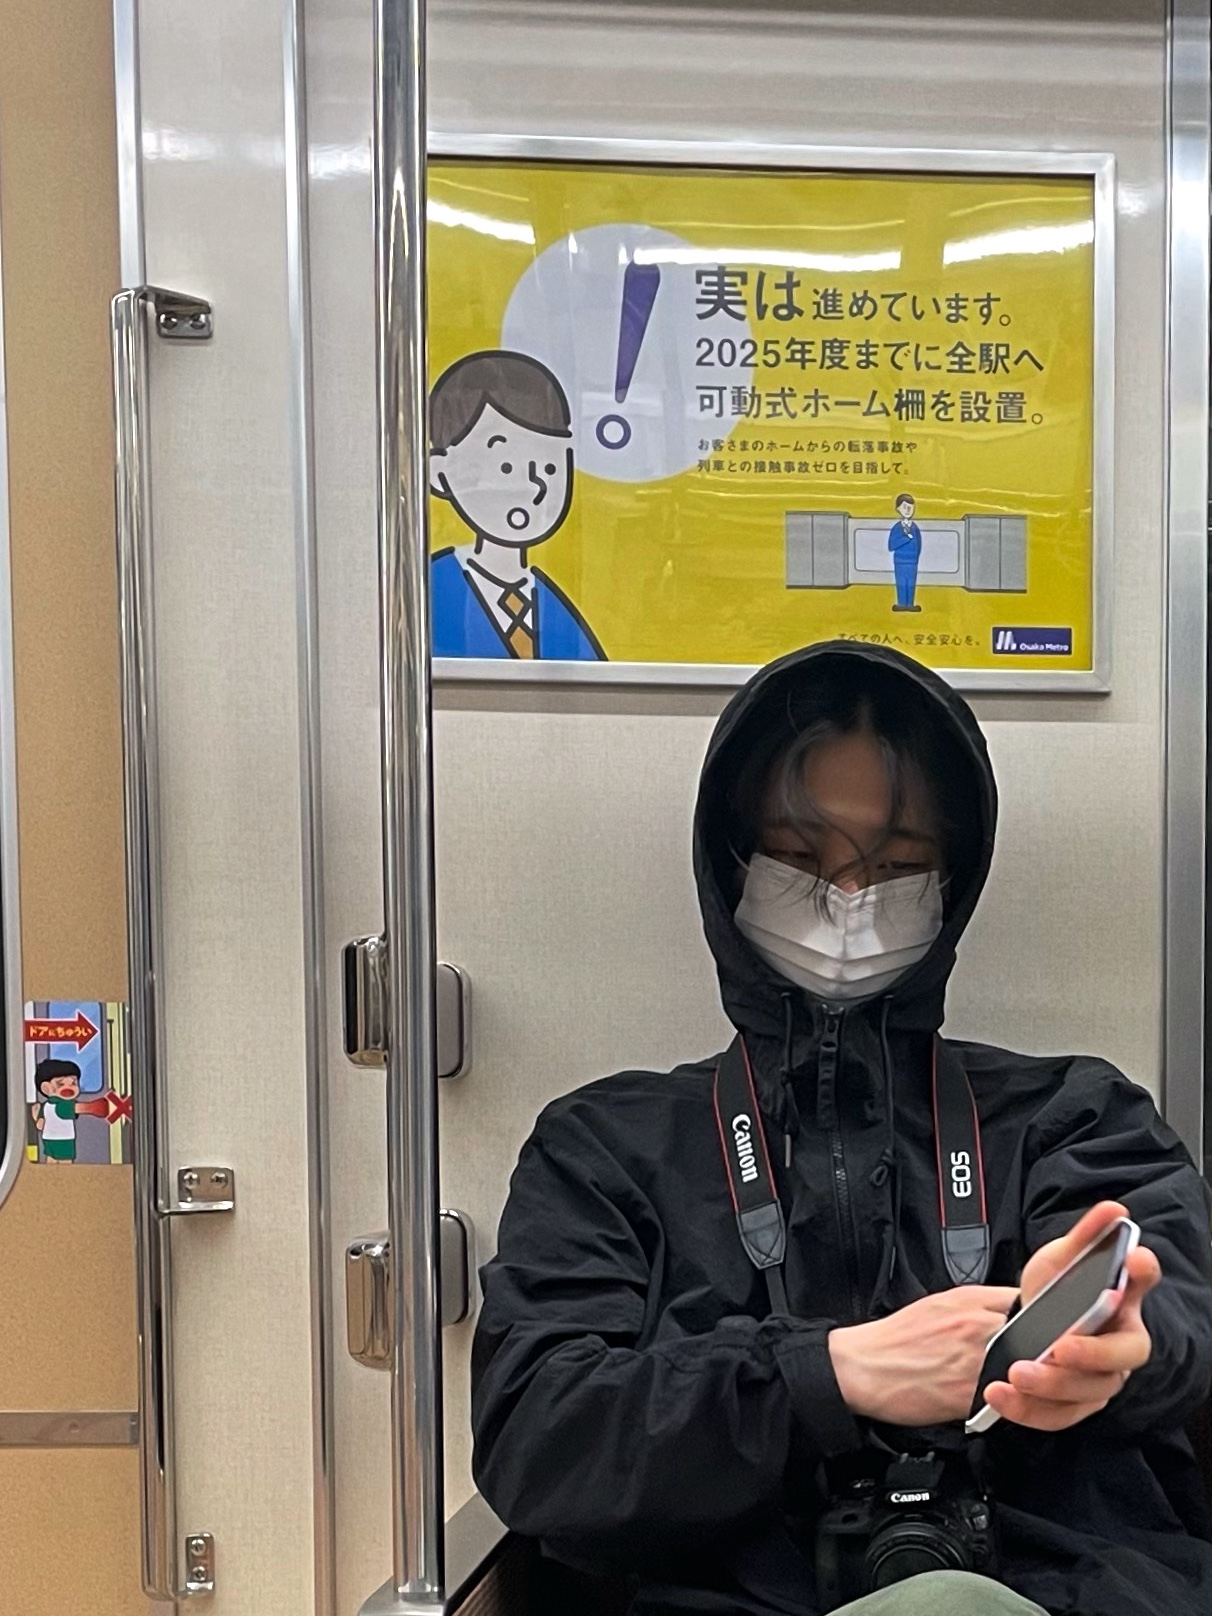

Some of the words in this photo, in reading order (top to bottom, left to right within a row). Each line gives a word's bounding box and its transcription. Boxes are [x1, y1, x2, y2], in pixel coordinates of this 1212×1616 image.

[694, 336, 1045, 375] 2025年度までに全駅へ
[695, 385, 1045, 426] 可動式ホーム柵を設置。
[698, 438, 918, 454] お客さまのホームからの転落事故や
[697, 459, 910, 475] 列車との接触事故ゼロを目指して。
[1019, 643, 1044, 651] Osaka
[1045, 643, 1069, 651] Metro
[29, 1026, 93, 1038] ドアにちゅうい
[731, 1114, 760, 1184] Canon
[950, 1150, 973, 1199] EOS
[890, 1492, 930, 1503] Canon
